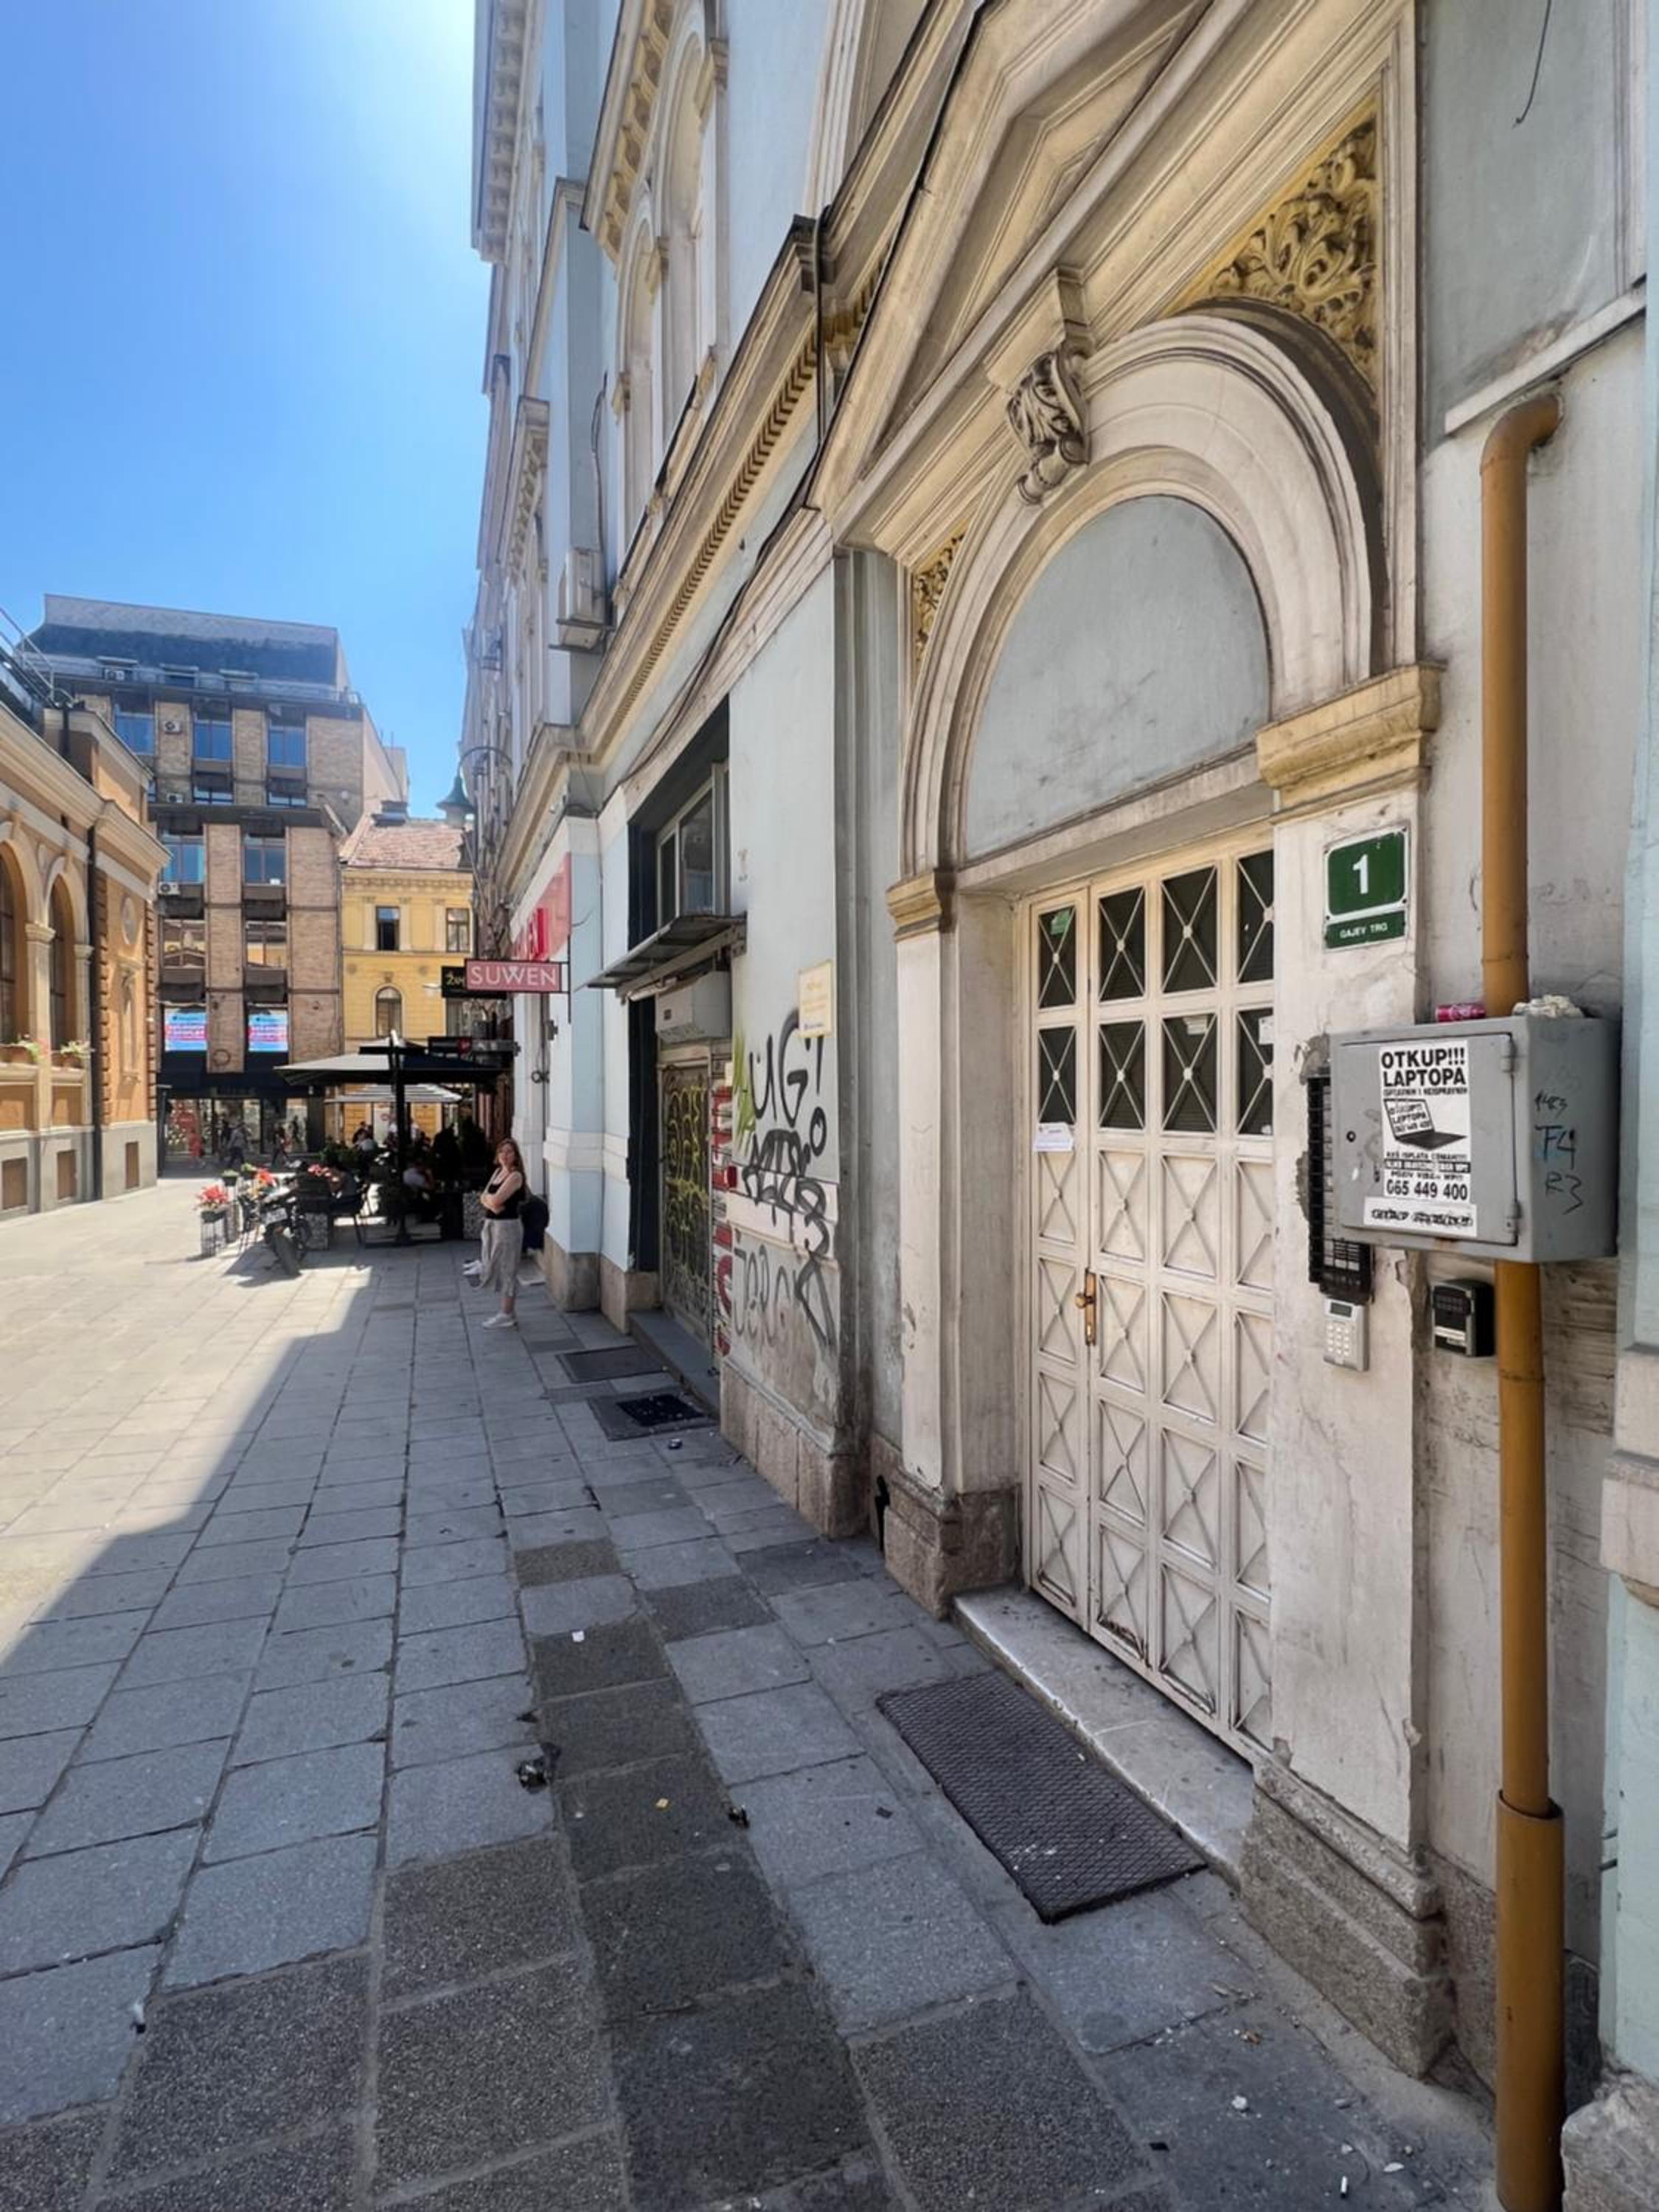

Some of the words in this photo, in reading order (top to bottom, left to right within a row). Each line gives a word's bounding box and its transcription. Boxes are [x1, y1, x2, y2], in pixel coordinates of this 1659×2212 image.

[1352, 853, 1369, 894] 1
[1339, 926, 1367, 939] GAJEV
[1370, 922, 1388, 933] TRG
[470, 966, 557, 986] SUWEN
[1381, 1047, 1465, 1069] OTKUP!!!
[1382, 1067, 1467, 1088] LAPTOPA
[1386, 1179, 1410, 1196] 065
[1414, 1181, 1438, 1198] 449
[1443, 1183, 1468, 1200] 400
